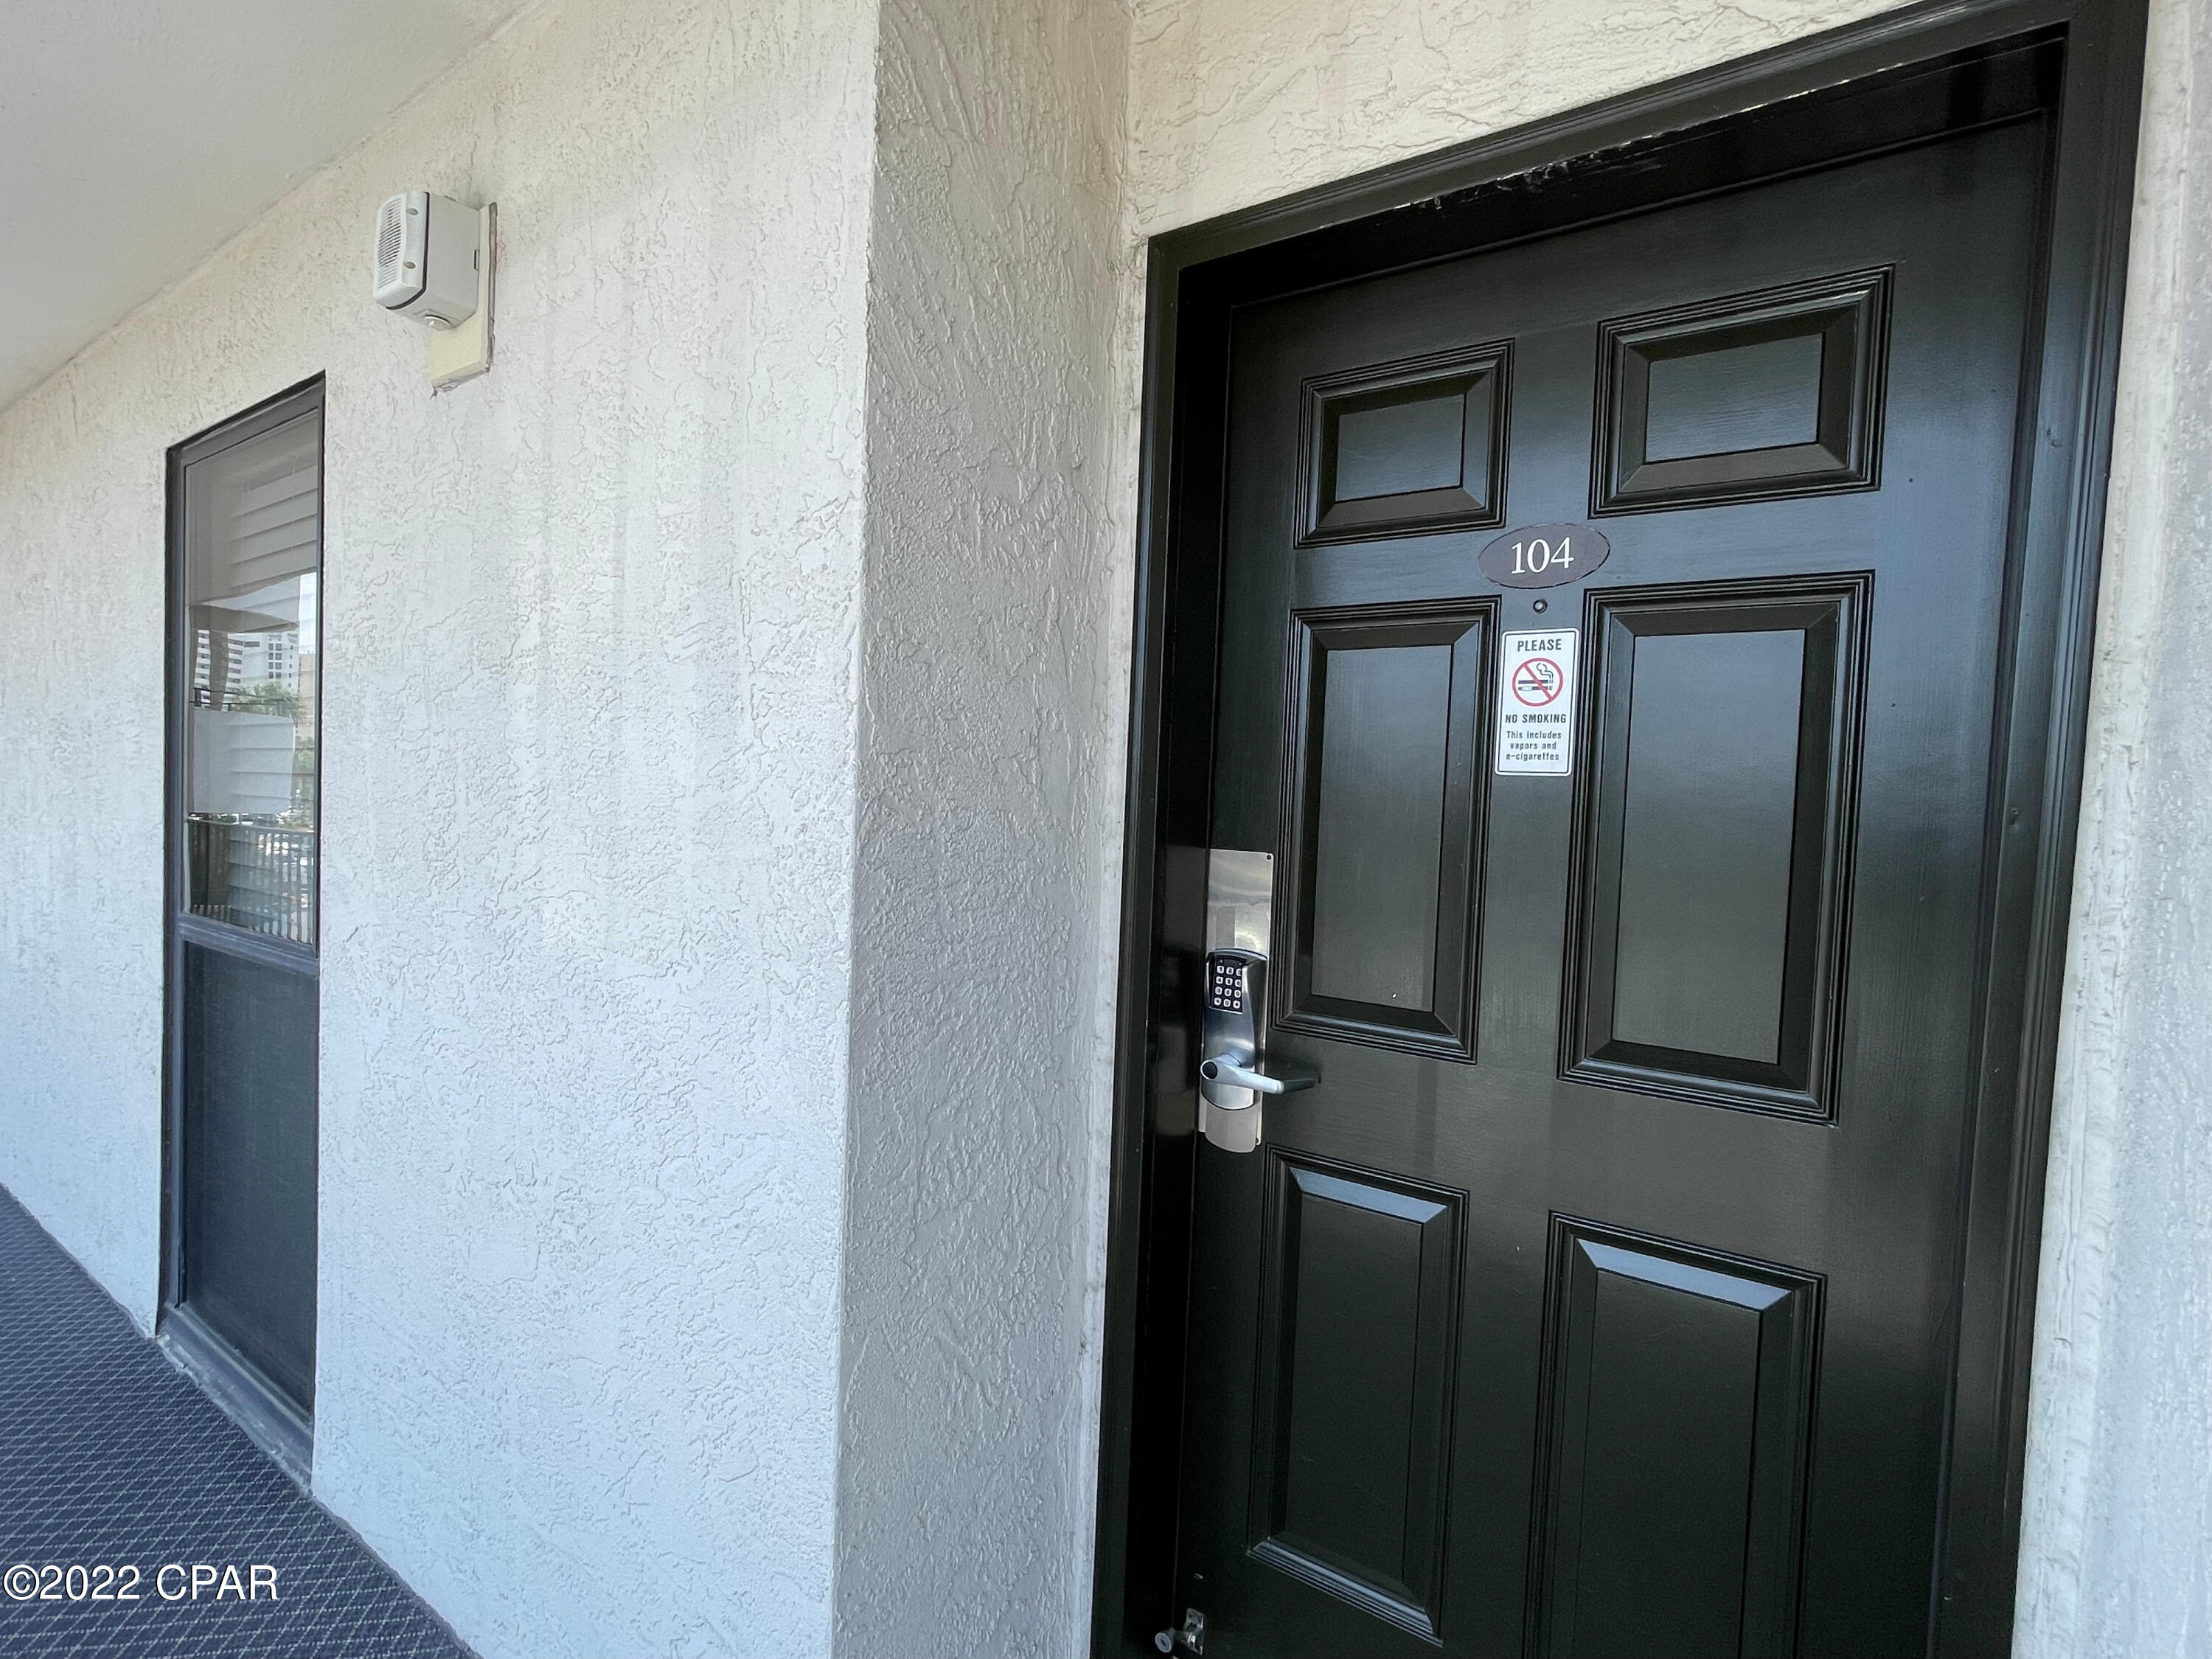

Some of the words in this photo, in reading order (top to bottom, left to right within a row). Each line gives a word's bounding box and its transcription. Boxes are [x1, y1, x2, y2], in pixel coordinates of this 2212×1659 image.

[1510, 536, 1575, 574] 104
[1517, 639, 1562, 653] PLEASE
[1505, 714, 1518, 723] NO
[1521, 713, 1567, 723] SMOKING
[1506, 731, 1523, 739] This
[1526, 731, 1562, 739] includes
[1509, 742, 1538, 751] vapors
[1541, 741, 1557, 750] and
[1506, 752, 1560, 762] e-cigarettes
